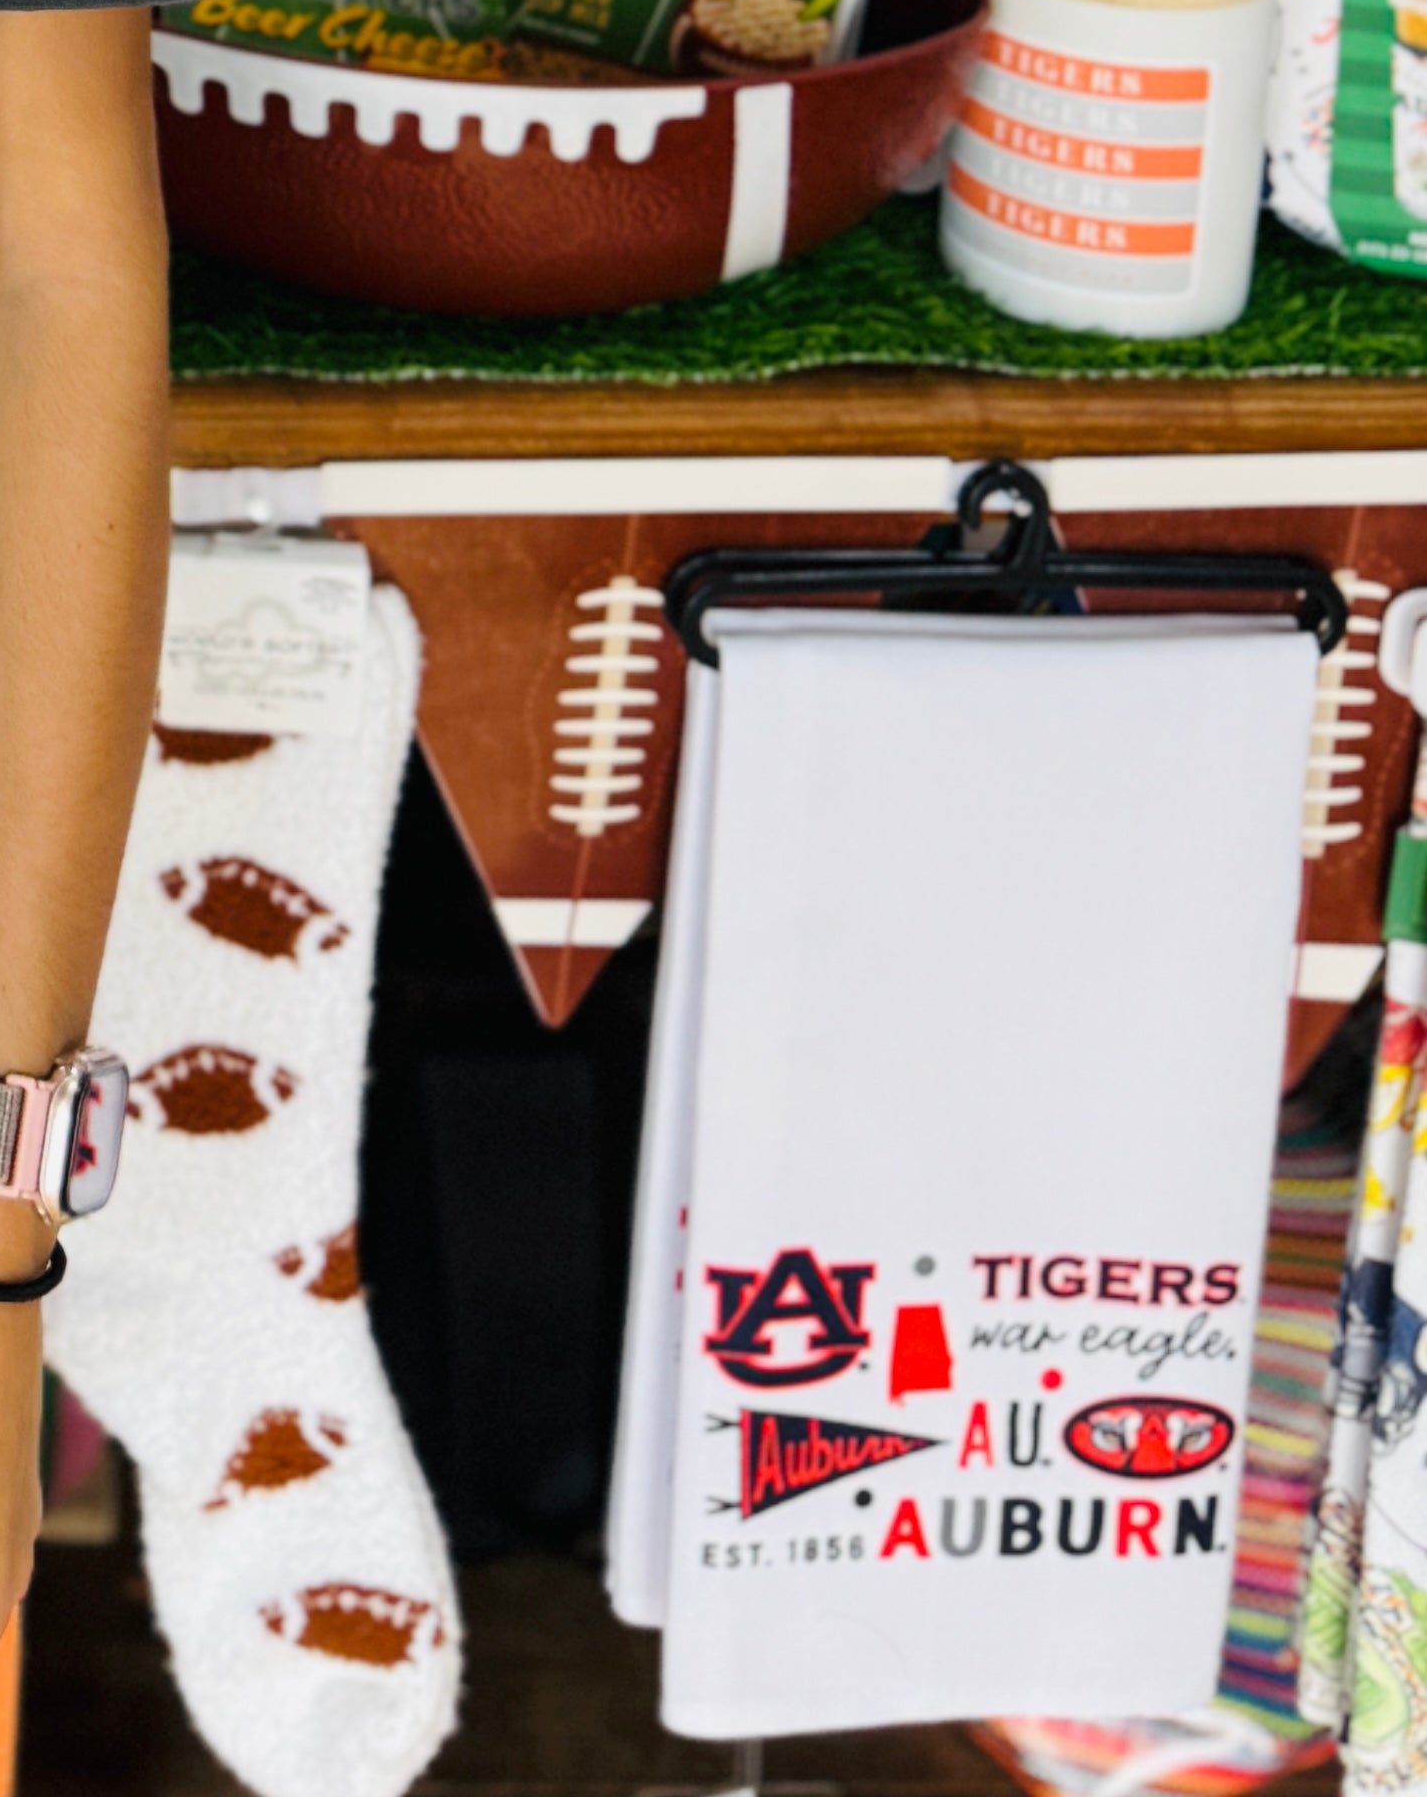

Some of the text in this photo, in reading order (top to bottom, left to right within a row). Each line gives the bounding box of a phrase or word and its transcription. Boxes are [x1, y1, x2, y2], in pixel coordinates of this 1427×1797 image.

[997, 41, 1142, 97] TIGERS
[994, 79, 1138, 135] TIGERS
[992, 117, 1136, 174] TIGERS
[991, 156, 1132, 210] TIGERS
[986, 192, 1128, 250] TIGERS
[972, 1254, 1241, 1307] TIGERS
[970, 1322, 1067, 1352] war
[751, 1413, 912, 1504] Auburn
[702, 1534, 865, 1568] EST. 1856
